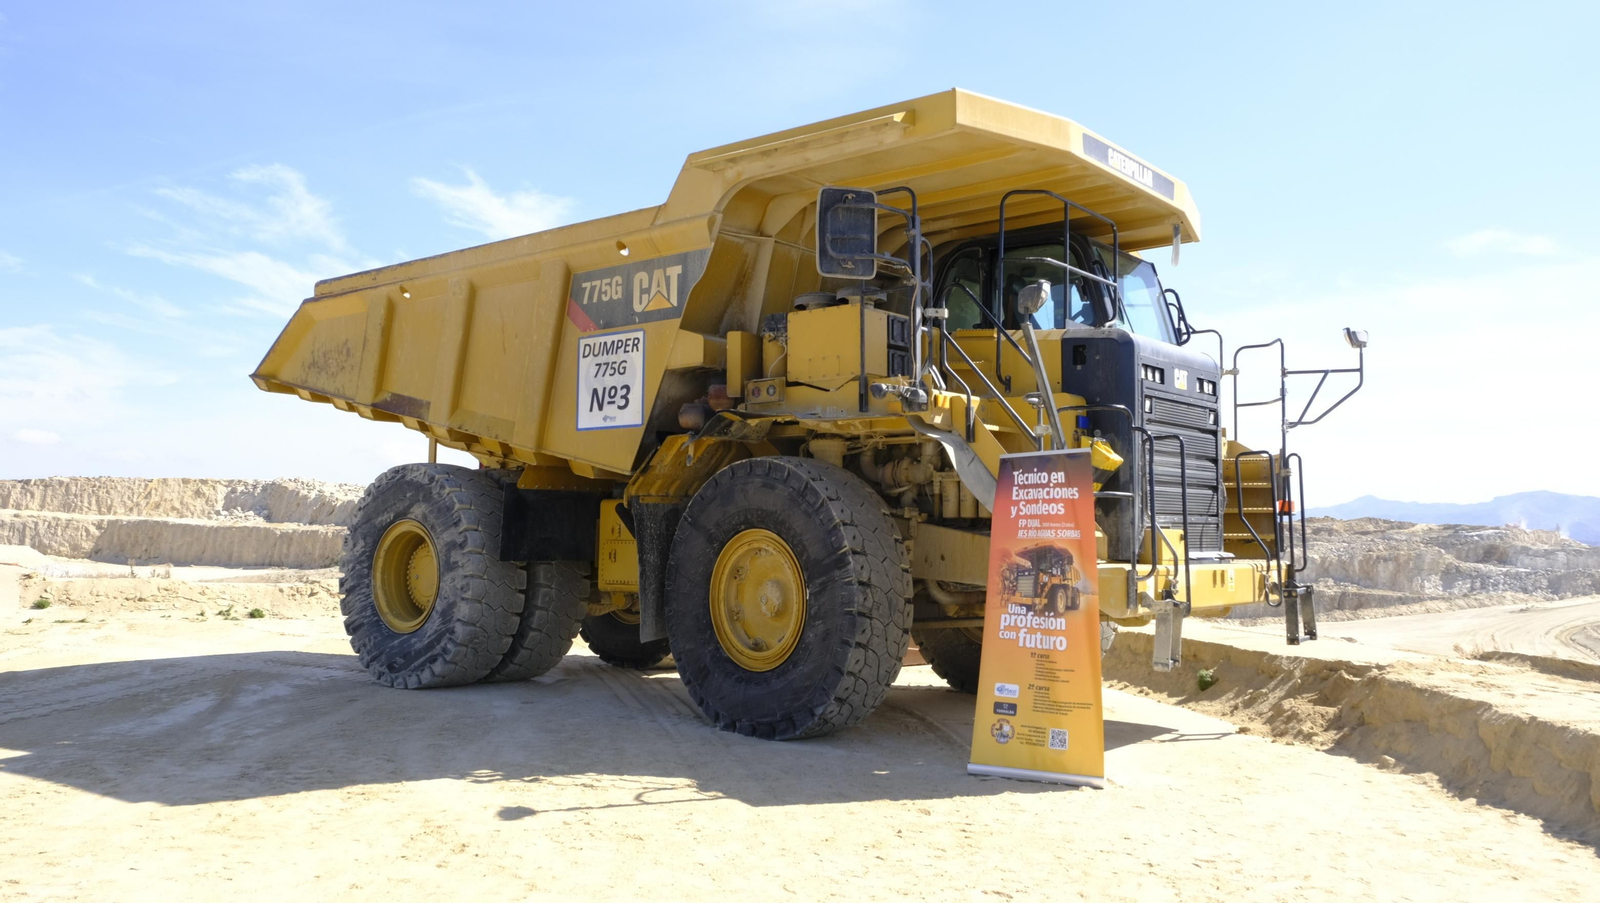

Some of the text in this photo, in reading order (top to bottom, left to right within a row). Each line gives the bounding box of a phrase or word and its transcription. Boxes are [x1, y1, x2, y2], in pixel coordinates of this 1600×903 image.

[1108, 147, 1153, 188] CATERPILLAR
[582, 264, 682, 312] 775G CAT
[582, 337, 641, 358] DUMPER
[594, 360, 627, 378] 775G
[1174, 368, 1188, 390] CAT
[1013, 468, 1065, 485] Técnico en
[1012, 483, 1079, 500] Excavaciones
[1010, 499, 1065, 518] y Sondeos
[1018, 519, 1027, 527] FP
[1027, 519, 1041, 527] DUAL
[1018, 529, 1028, 537] IES
[1037, 529, 1056, 537] AGUAS
[1056, 529, 1081, 538] SORBAS
[1008, 603, 1026, 614] Una
[1000, 611, 1066, 630] profesión
[999, 628, 1067, 651] con futuro
